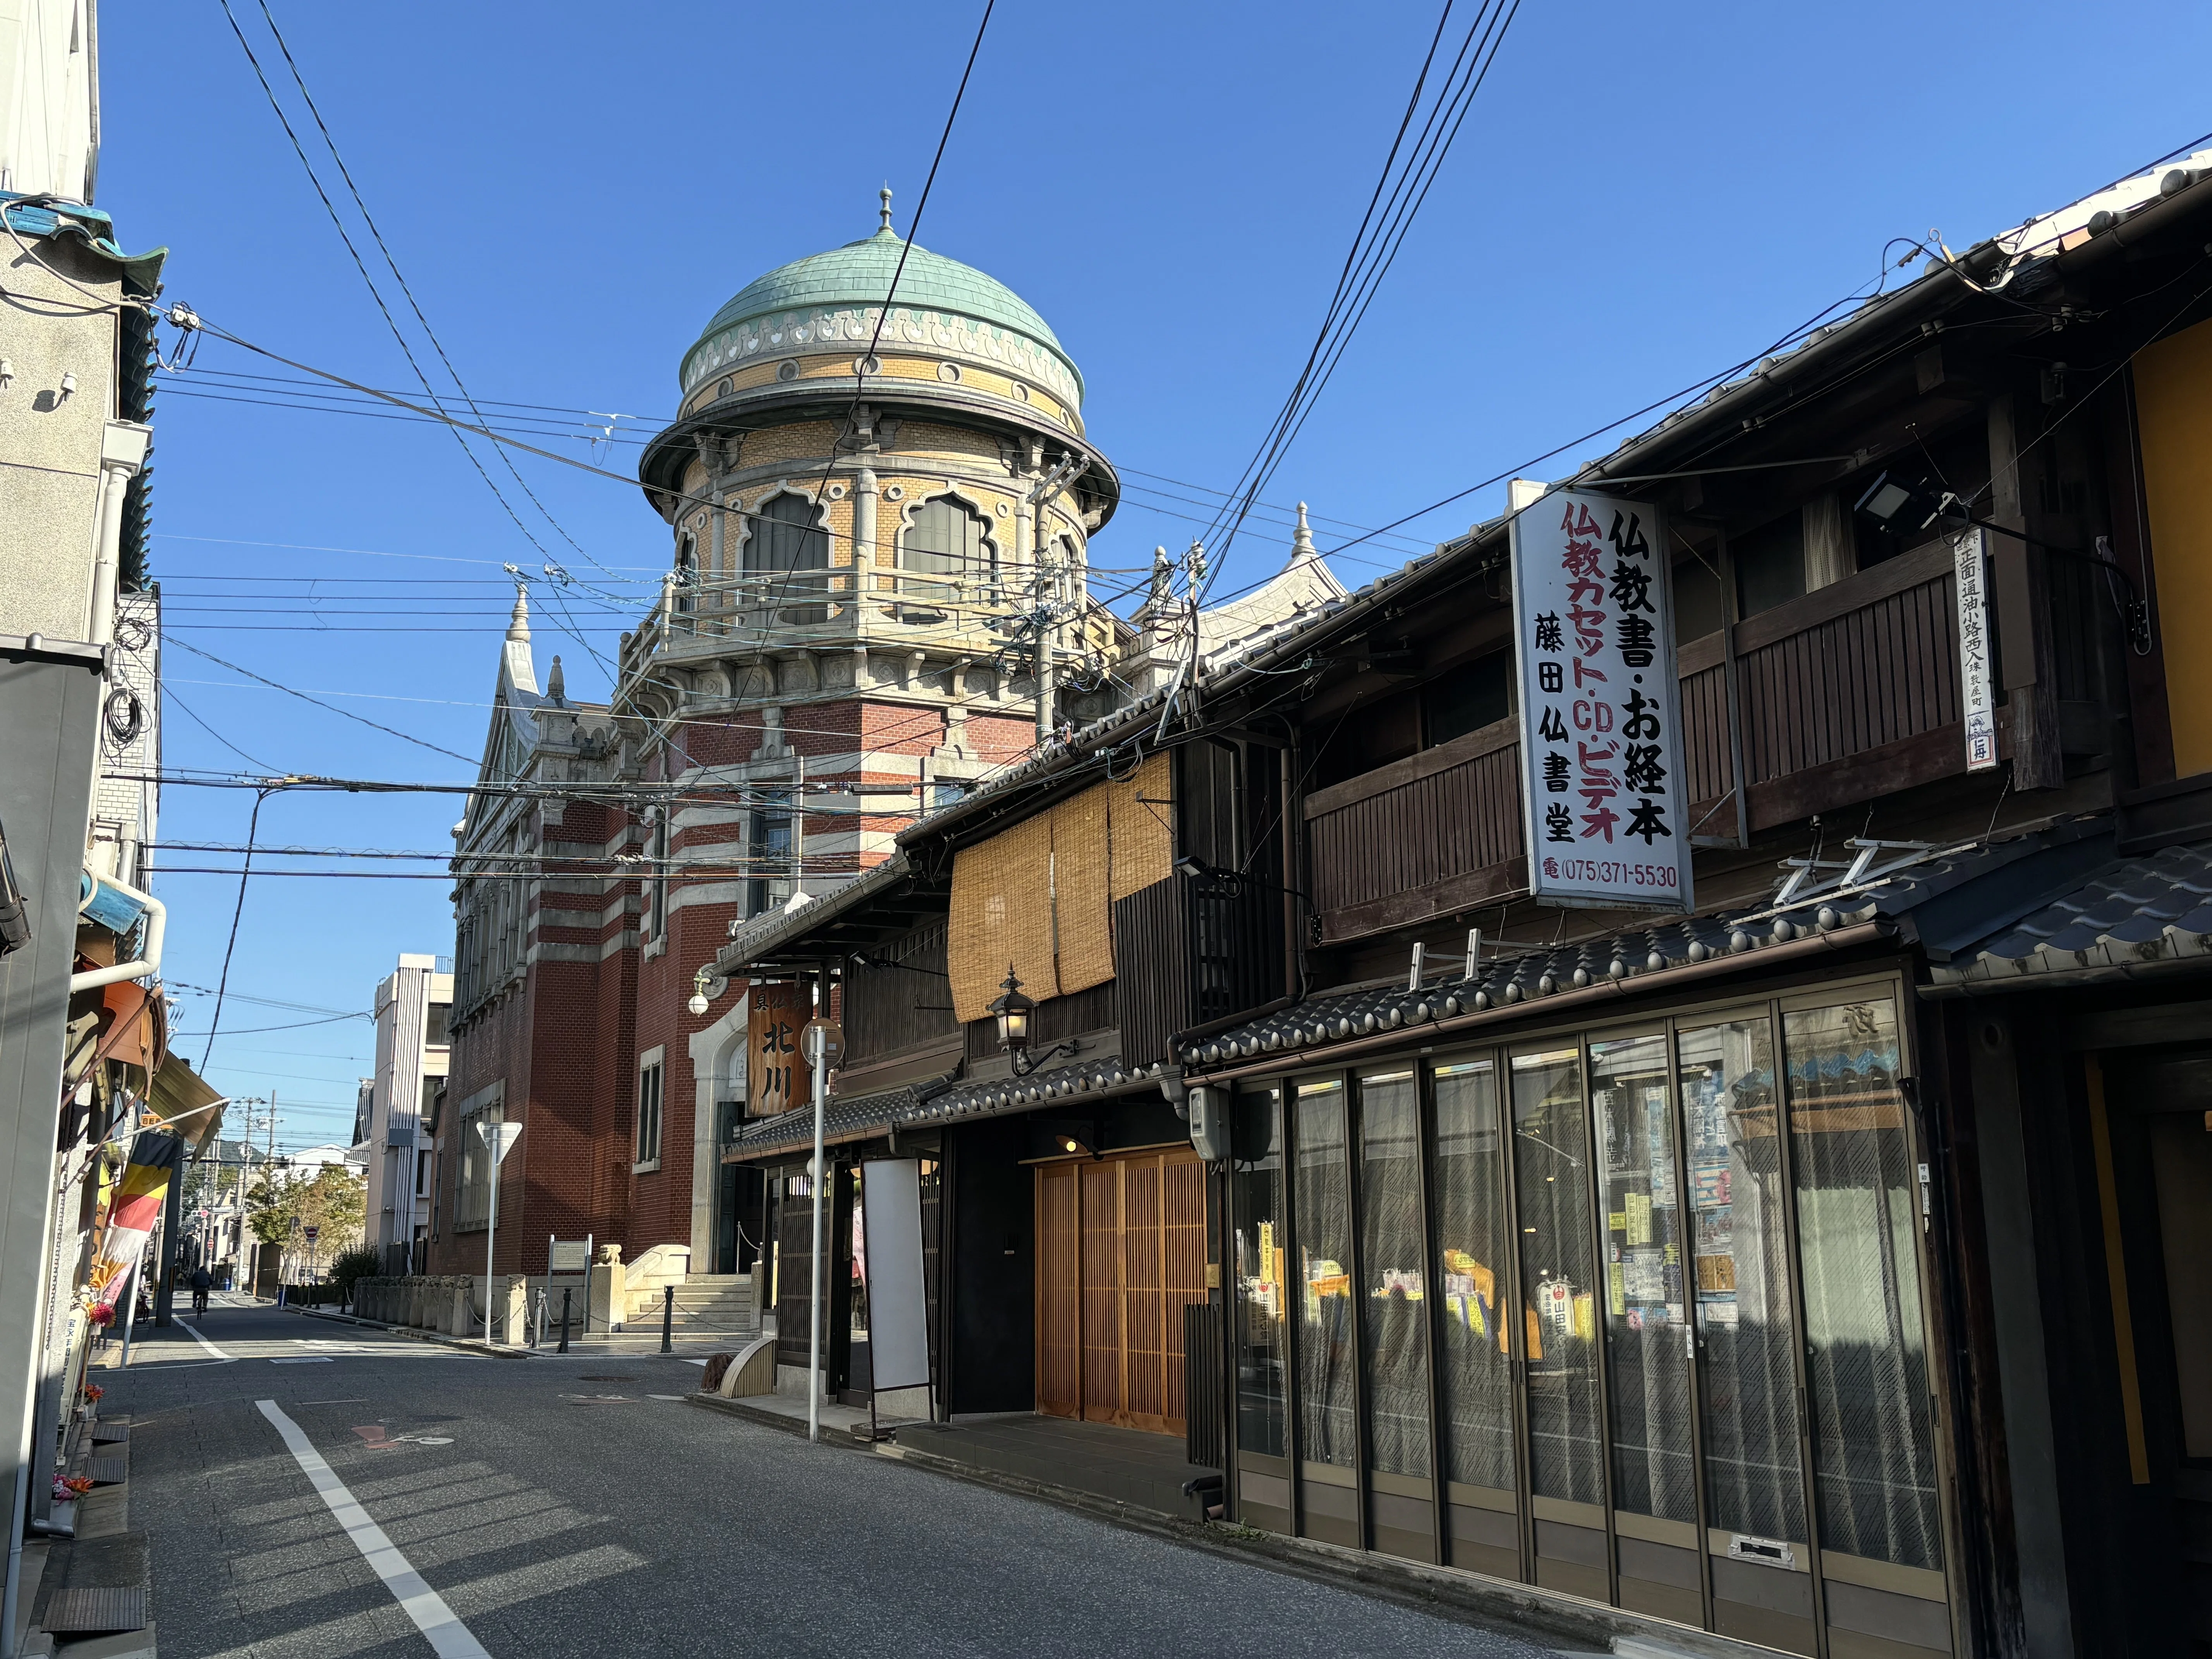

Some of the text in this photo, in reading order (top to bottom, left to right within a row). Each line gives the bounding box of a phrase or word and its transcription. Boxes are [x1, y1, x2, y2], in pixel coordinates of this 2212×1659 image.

[1534, 610, 1575, 843] 藤田仏書堂
[1561, 501, 1621, 844] 仏教カセット・CD・ビデオ
[1608, 509, 1672, 845] 仏教書・お経本
[761, 1021, 795, 1100] 北川
